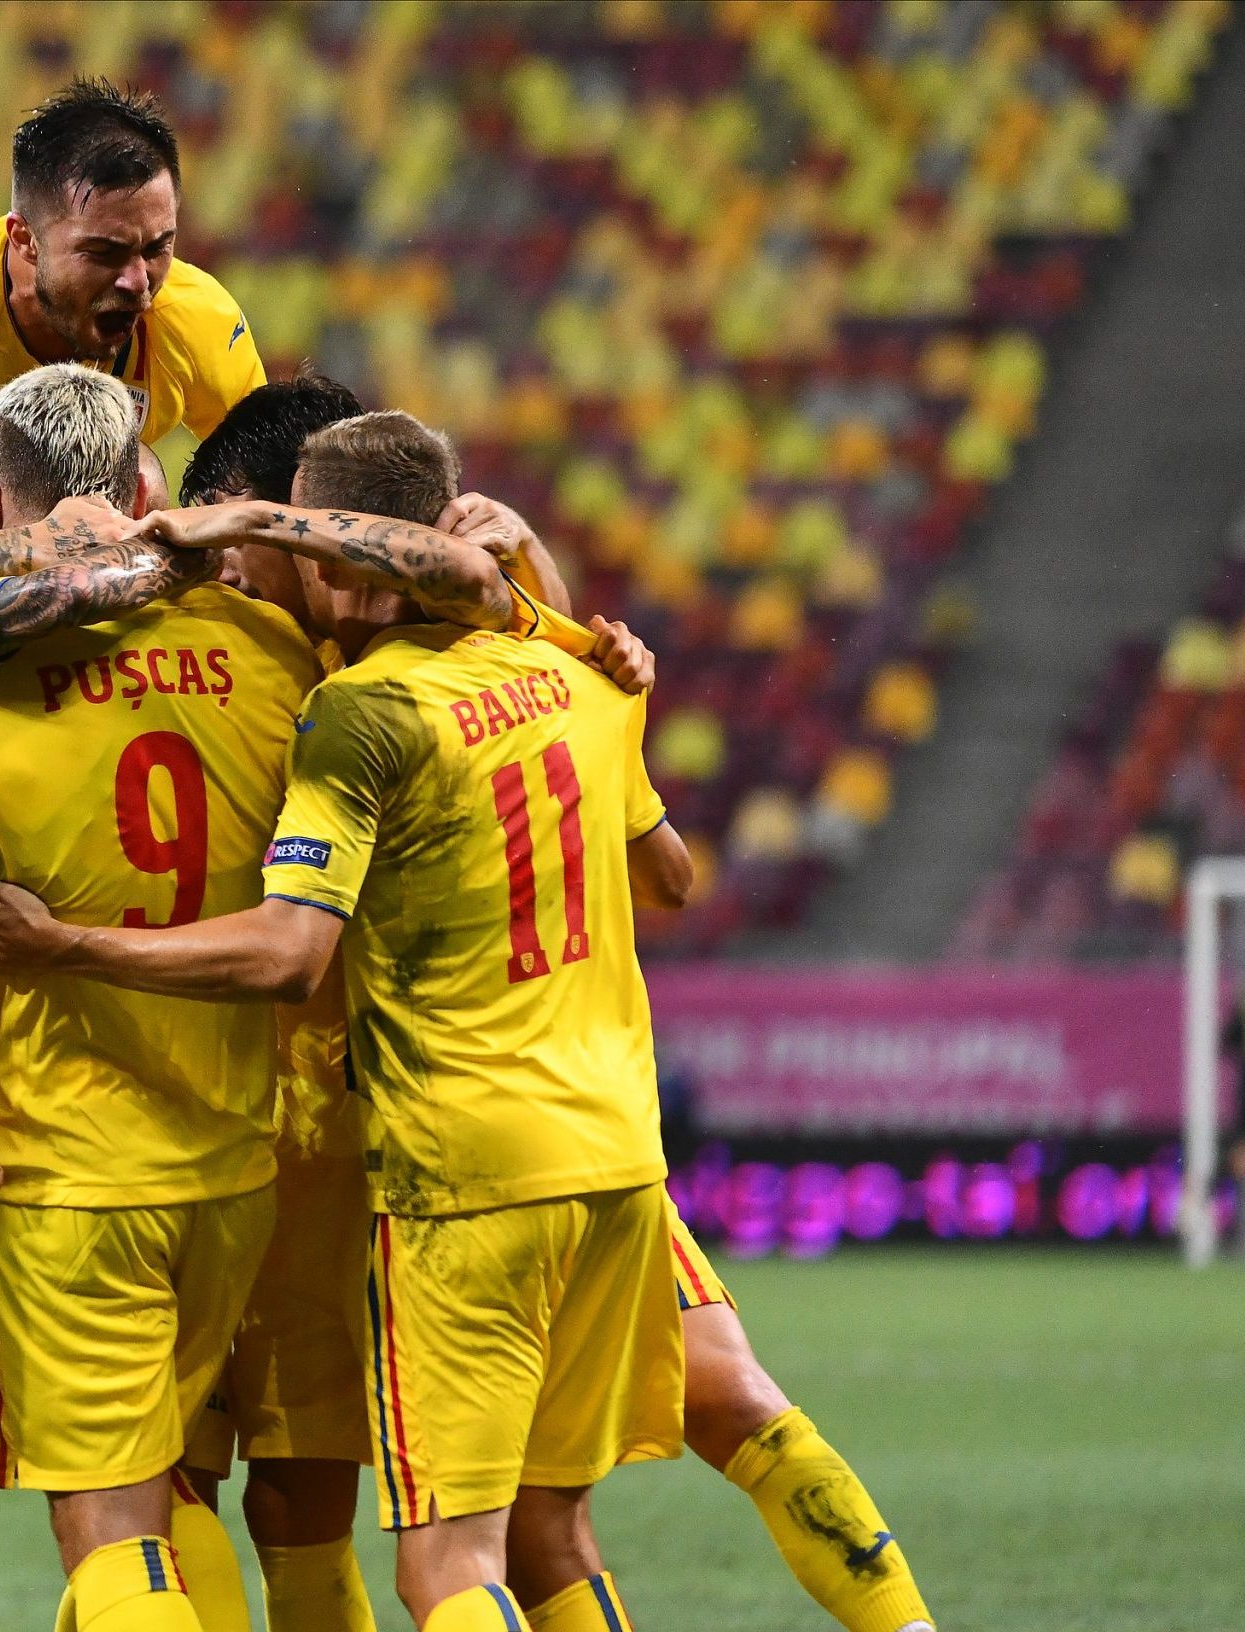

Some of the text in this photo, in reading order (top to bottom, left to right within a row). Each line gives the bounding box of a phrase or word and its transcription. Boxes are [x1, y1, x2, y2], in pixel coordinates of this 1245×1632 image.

[36, 648, 233, 713] PUȘCAȘ
[450, 669, 571, 747] BANCU
[114, 730, 208, 930] 9
[274, 843, 329, 862] RESPECT
[491, 740, 589, 984] 11
